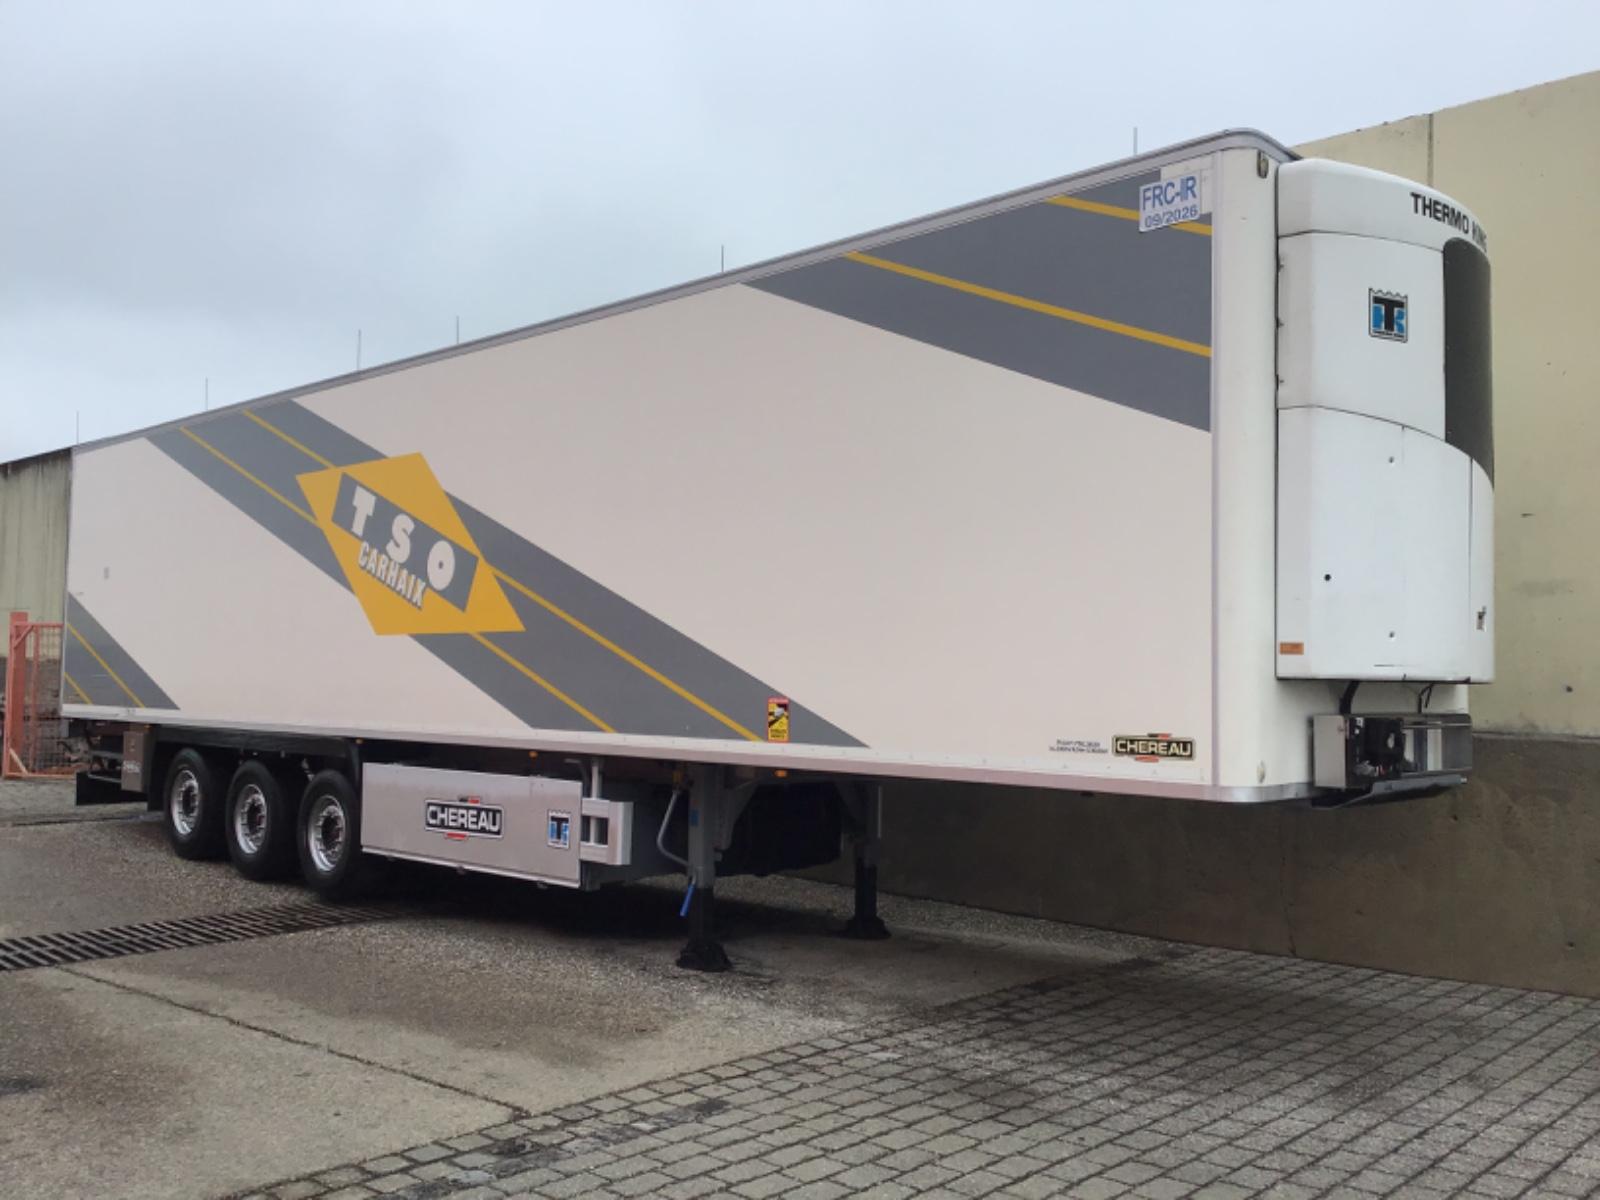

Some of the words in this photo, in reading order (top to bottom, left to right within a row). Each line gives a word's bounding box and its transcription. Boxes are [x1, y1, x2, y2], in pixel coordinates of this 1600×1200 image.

[1142, 175, 1197, 211] FRC-IR
[1144, 205, 1198, 228] 09/2026
[1410, 192, 1470, 235] THERMO
[358, 540, 427, 611] CARHAIX
[1116, 740, 1191, 756] CHEREAU
[427, 805, 501, 832] CHEREAU
